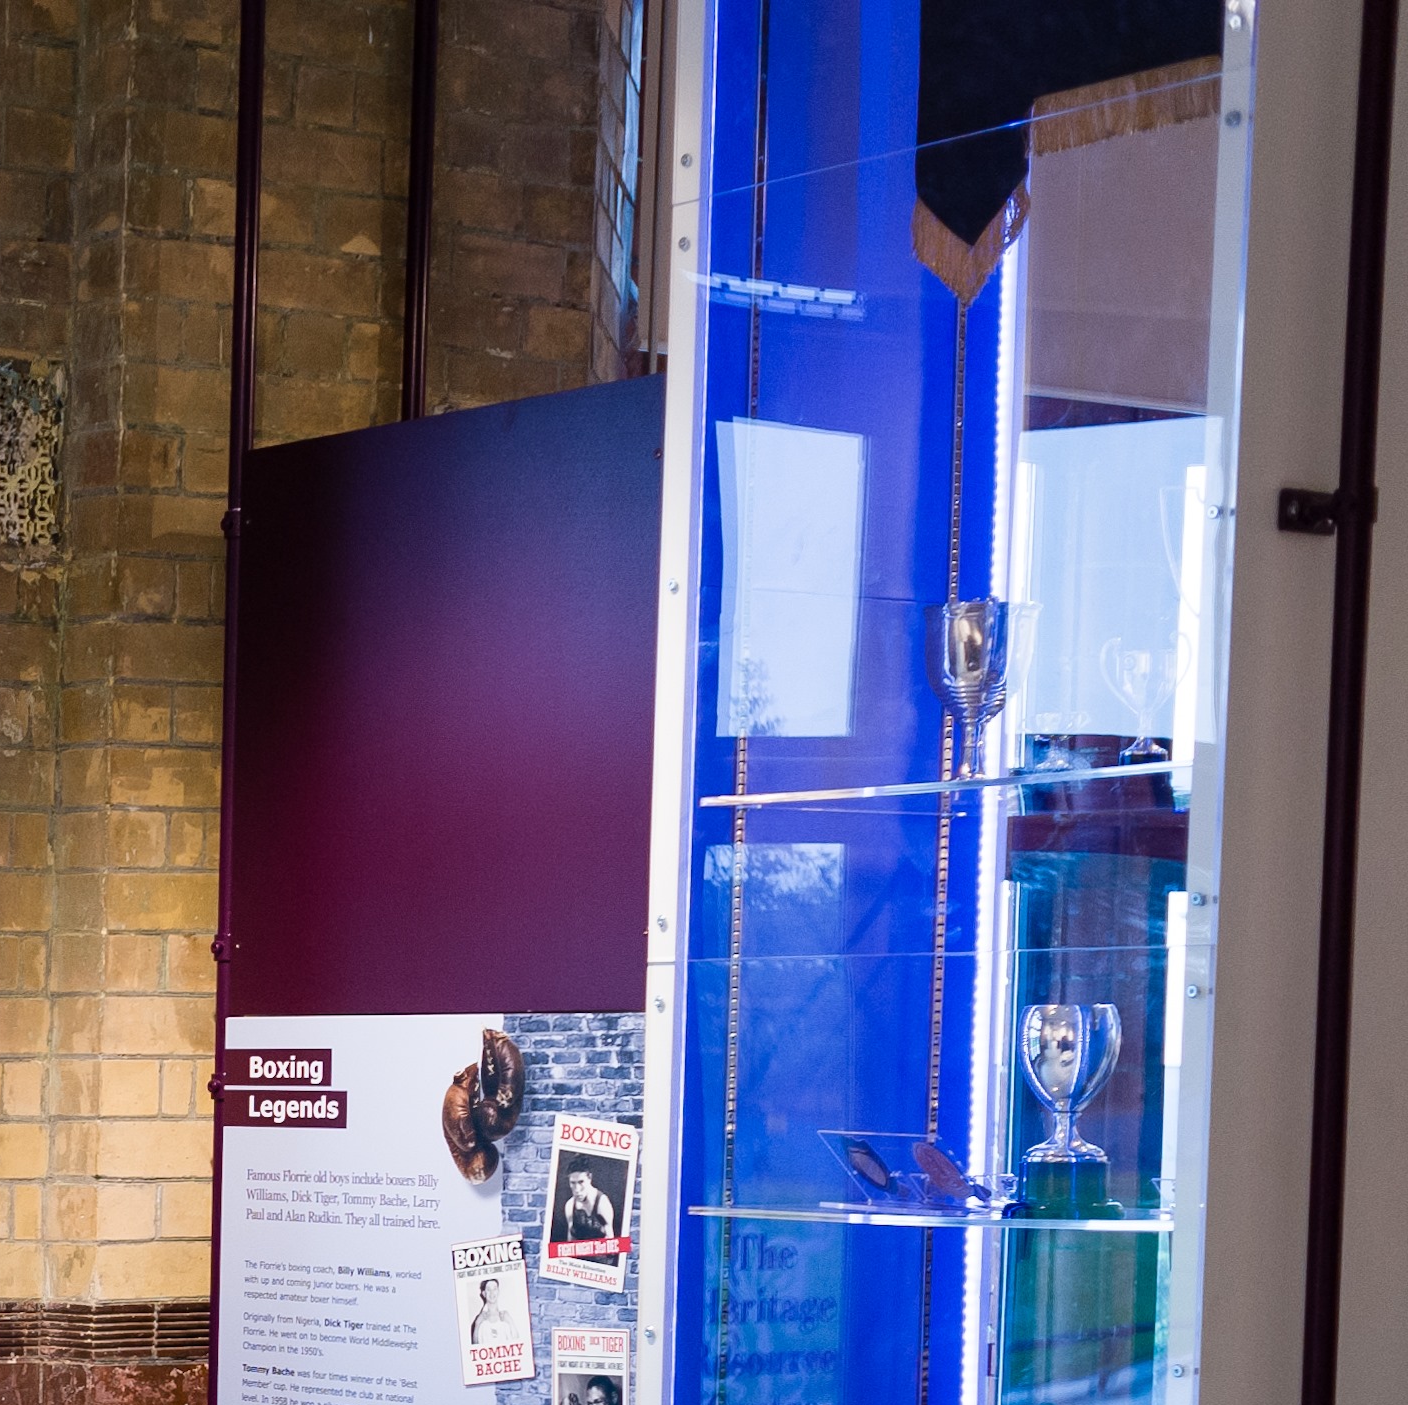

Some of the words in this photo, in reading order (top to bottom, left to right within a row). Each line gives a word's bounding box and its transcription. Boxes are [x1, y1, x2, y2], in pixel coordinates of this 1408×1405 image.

[249, 1055, 324, 1085] Boxing
[248, 1095, 339, 1124] Legends
[560, 1123, 632, 1150] BOXING
[247, 1169, 280, 1181] Famous
[283, 1170, 311, 1183] Florrie
[314, 1170, 326, 1183] old
[330, 1171, 349, 1187] boys
[352, 1172, 383, 1185] include
[386, 1173, 415, 1186] boxers
[418, 1174, 439, 1190] Billy
[292, 1190, 311, 1203] Dick
[315, 1191, 339, 1207] Tiger,
[342, 1192, 376, 1209] Tommy
[380, 1193, 409, 1209] Bache,
[413, 1195, 440, 1211] Larry
[246, 1208, 264, 1220] Paul
[267, 1209, 282, 1221] and
[285, 1210, 305, 1222] Alan
[345, 1213, 366, 1228] They
[369, 1214, 379, 1226] all
[383, 1215, 415, 1228] trained
[418, 1217, 440, 1229] here.
[454, 1241, 523, 1270] BOXING
[245, 1260, 257, 1269] The
[289, 1263, 310, 1274] boxing
[338, 1266, 354, 1277] Billy
[396, 1270, 422, 1279] worked
[546, 1265, 572, 1278] BILLY
[573, 1269, 617, 1286] WILLIAMS
[245, 1275, 258, 1284] with
[261, 1278, 269, 1286] up
[272, 1277, 284, 1285] and
[287, 1279, 311, 1290] coming
[313, 1280, 333, 1290] junior
[364, 1283, 373, 1292] He
[244, 1291, 277, 1300] respected
[280, 1294, 308, 1302] amateur
[310, 1294, 329, 1304] boxer
[244, 1312, 274, 1324] Originally
[277, 1314, 293, 1323] from
[325, 1318, 340, 1328] Dick
[344, 1320, 363, 1331] Tiger
[366, 1322, 390, 1332] trained
[403, 1324, 416, 1334] The
[243, 1341, 276, 1352] Champion
[287, 1345, 298, 1354] the
[269, 1329, 278, 1338] He
[281, 1331, 297, 1339] went
[320, 1333, 346, 1343] become
[350, 1336, 369, 1345] World
[372, 1337, 417, 1351] Middleweight
[558, 1335, 585, 1351] BOXING
[602, 1336, 624, 1352] TIGER
[470, 1343, 524, 1361] TOMMY
[243, 1364, 269, 1376] Tommy
[272, 1367, 294, 1376] Bache
[313, 1370, 326, 1379] four
[329, 1372, 347, 1382] times
[351, 1376, 373, 1384] winner
[376, 1376, 383, 1385] of
[386, 1378, 396, 1387] the
[476, 1359, 521, 1376] BACHE
[262, 1395, 269, 1403] In
[290, 1383, 299, 1392] He
[302, 1386, 343, 1397] represented
[346, 1389, 357, 1398] the
[359, 1390, 373, 1400] club
[385, 1394, 413, 1403] national
